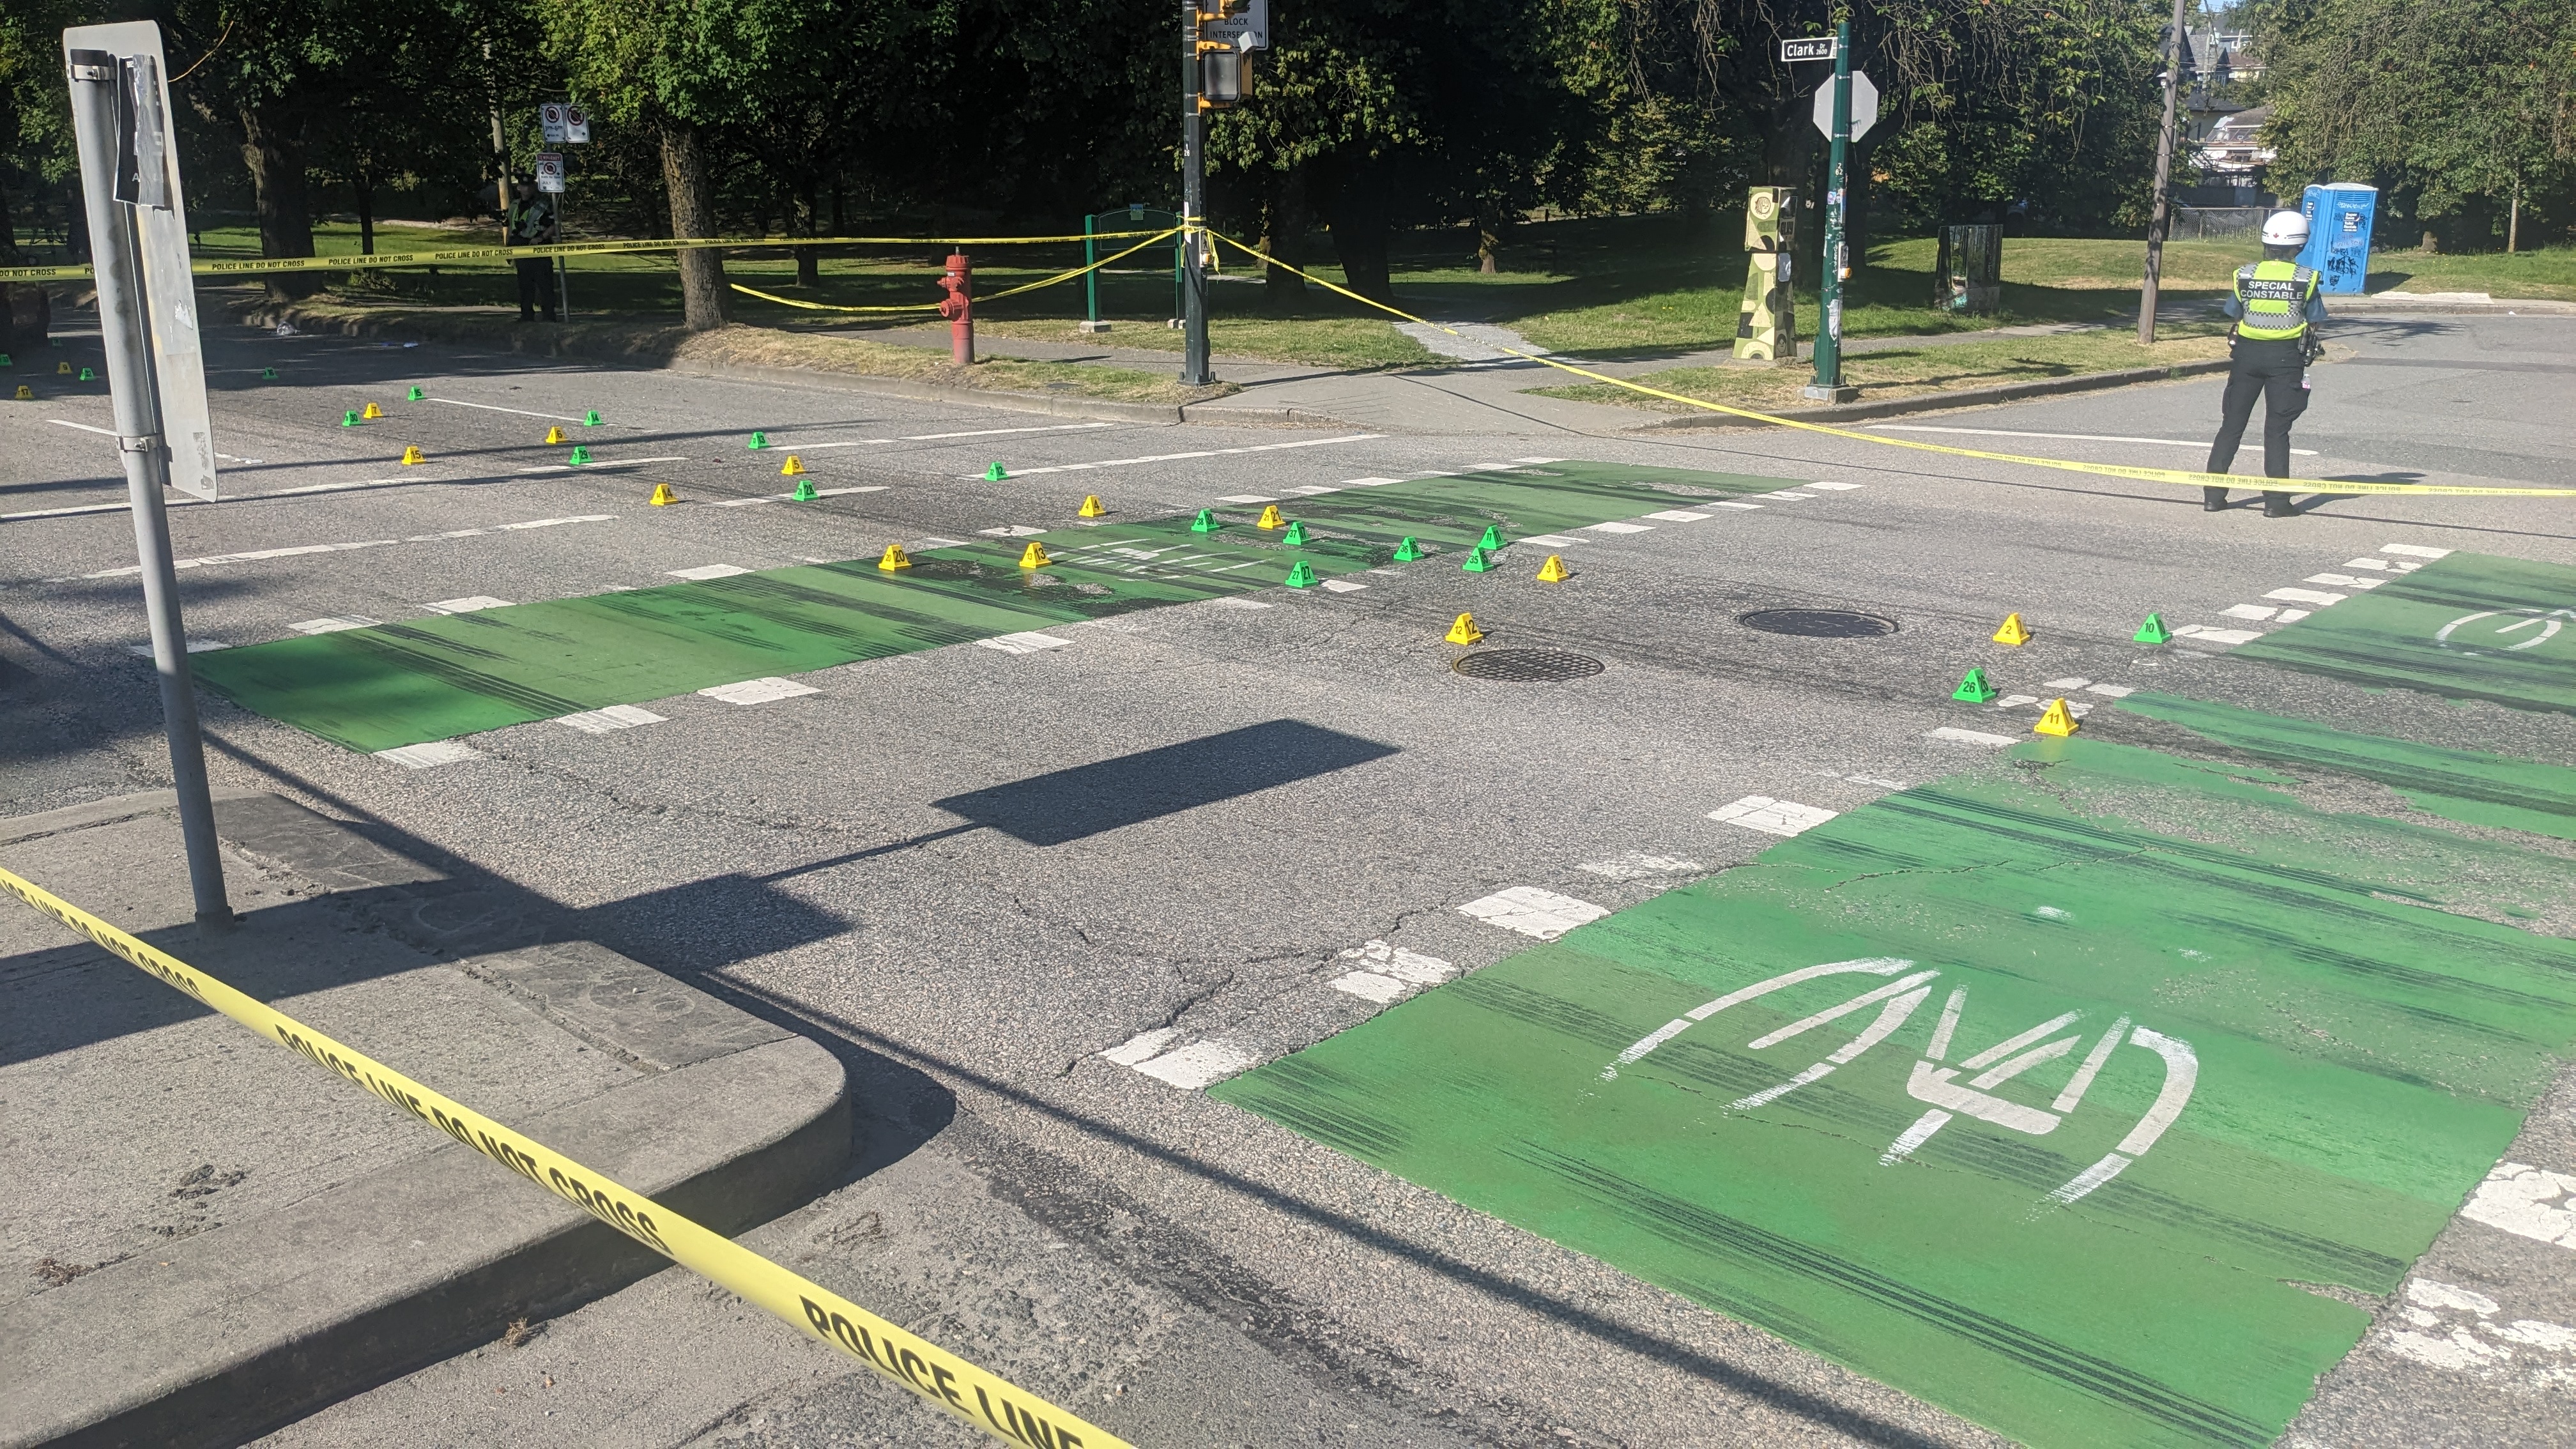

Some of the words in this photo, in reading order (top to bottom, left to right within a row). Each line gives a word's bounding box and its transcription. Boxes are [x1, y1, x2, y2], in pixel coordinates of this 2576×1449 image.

[1787, 43, 1814, 57] Clark
[2248, 281, 2294, 291] SPECIAL
[2240, 289, 2304, 299] CONSTABLE
[411, 450, 421, 459] 15
[579, 450, 588, 459] 29
[793, 460, 800, 469] 5
[995, 466, 1004, 476] 12
[663, 488, 673, 499] 14
[804, 484, 814, 495] 28
[1094, 499, 1100, 510] 4
[1205, 513, 1214, 525] 38
[1270, 510, 1281, 522] 21
[1289, 529, 1297, 538] 37
[1300, 526, 1306, 539] 37
[1493, 530, 1500, 542] 11
[1400, 545, 1408, 554] 36
[1409, 540, 1418, 553] 36
[893, 549, 905, 563] 20
[1034, 547, 1045, 561] 13
[1469, 555, 1478, 564] 35
[1546, 565, 1551, 573] 3
[1555, 561, 1562, 573] 3
[1291, 570, 1299, 580] 27
[1300, 566, 1311, 580] 27
[1454, 625, 1461, 635] 12
[1464, 619, 1477, 635] 12
[2005, 625, 2012, 635] 2
[2017, 619, 2024, 635] 2
[2145, 623, 2155, 633] 10
[1962, 681, 1976, 694] 26
[1977, 674, 1989, 693] 26
[2048, 713, 2060, 724] 11
[30, 894, 68, 923] LINE
[68, 914, 102, 946] DO
[96, 930, 141, 968] NOT
[137, 951, 210, 1004] CROSS
[275, 1023, 366, 1087] POLICE
[365, 1071, 431, 1123] LINE
[429, 1105, 487, 1155] DO
[477, 1130, 552, 1190] NOT
[548, 1167, 673, 1255] CROSS
[799, 1294, 975, 1417] POLICE
